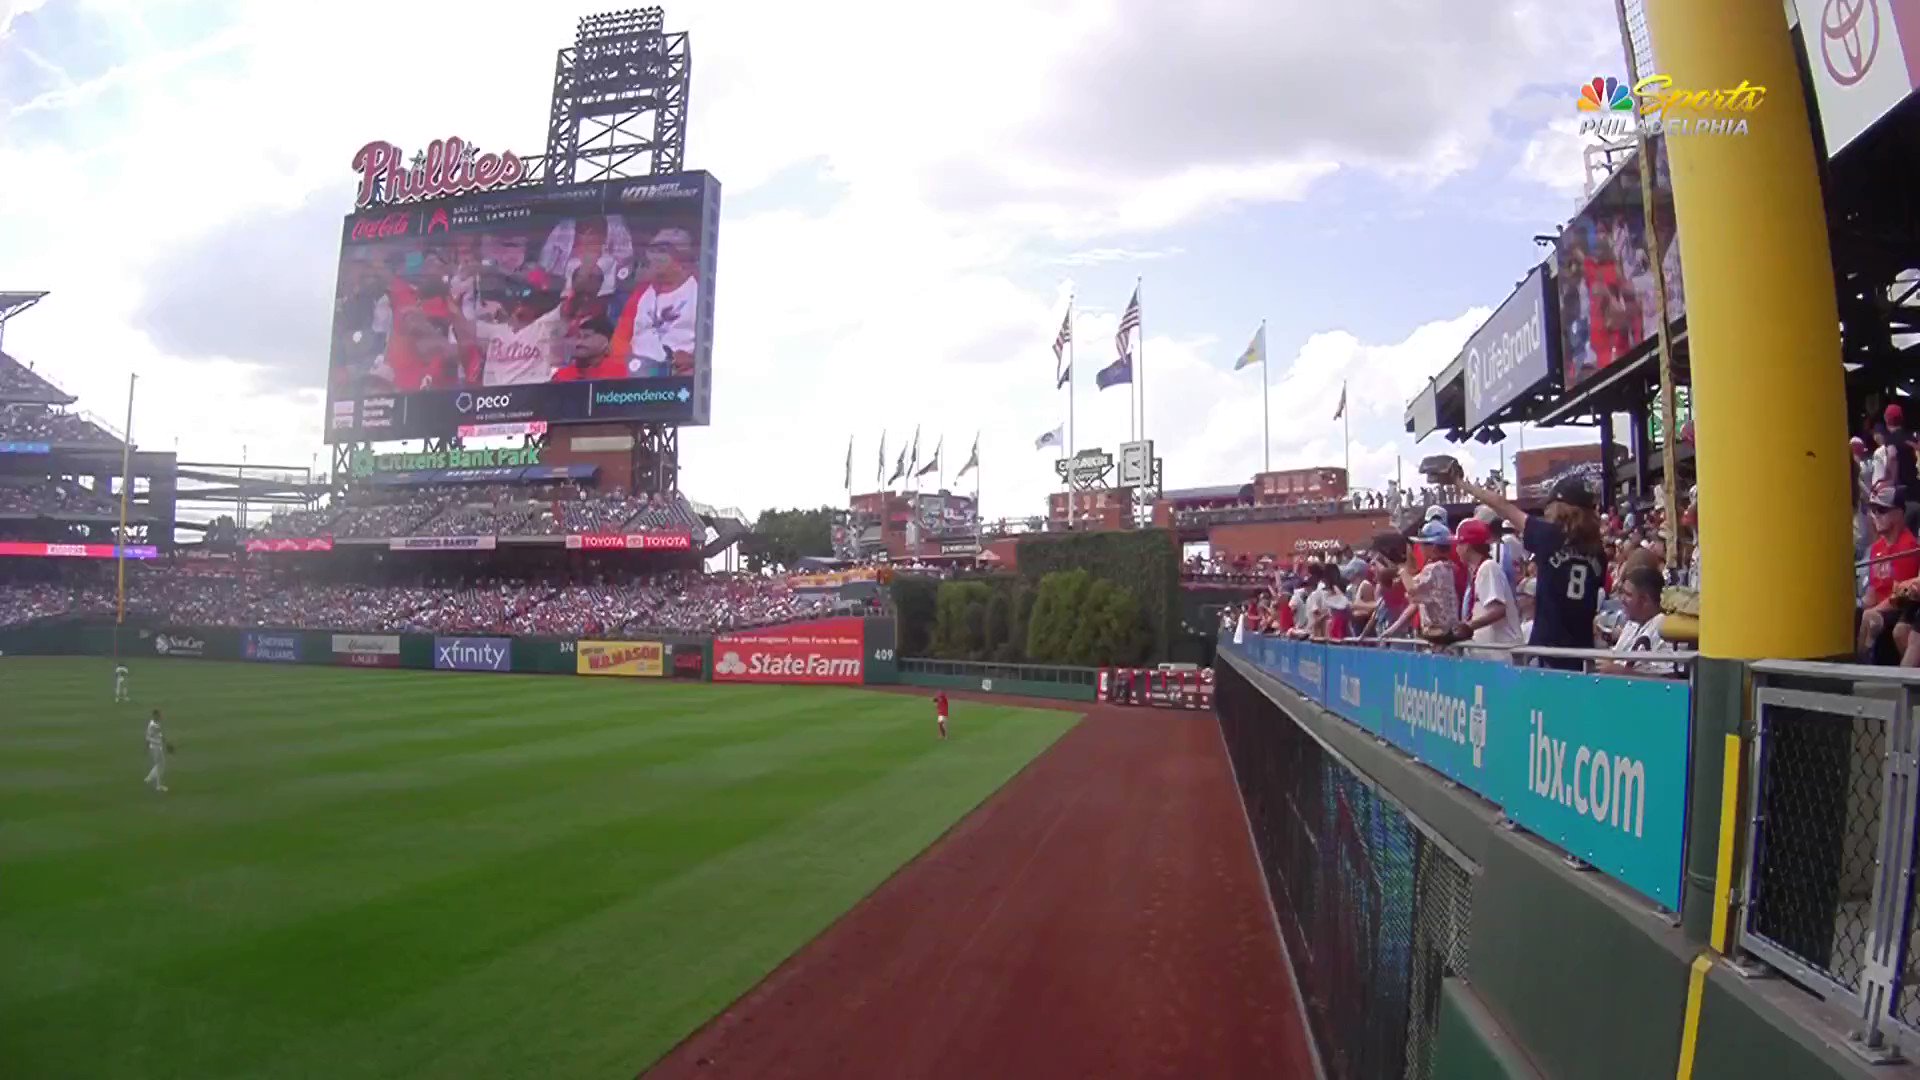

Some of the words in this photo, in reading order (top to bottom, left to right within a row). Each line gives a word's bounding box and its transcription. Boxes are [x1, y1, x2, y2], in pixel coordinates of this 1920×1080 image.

[351, 136, 525, 207] Phillies
[1483, 299, 1540, 389] LifeBrand
[476, 393, 510, 411] peco
[596, 389, 675, 405] Independence
[376, 451, 446, 471] Citizens
[449, 447, 495, 468] Bank
[497, 446, 540, 466] Park
[584, 537, 624, 547] TOYOTA
[646, 536, 687, 547] TOYOTA
[1307, 539, 1341, 549] TOYOTA
[1566, 564, 1588, 600] 8
[439, 638, 505, 669] xfinity
[874, 649, 894, 662] 409
[1394, 673, 1467, 745] Independence
[1528, 709, 1646, 839] ibx.com
